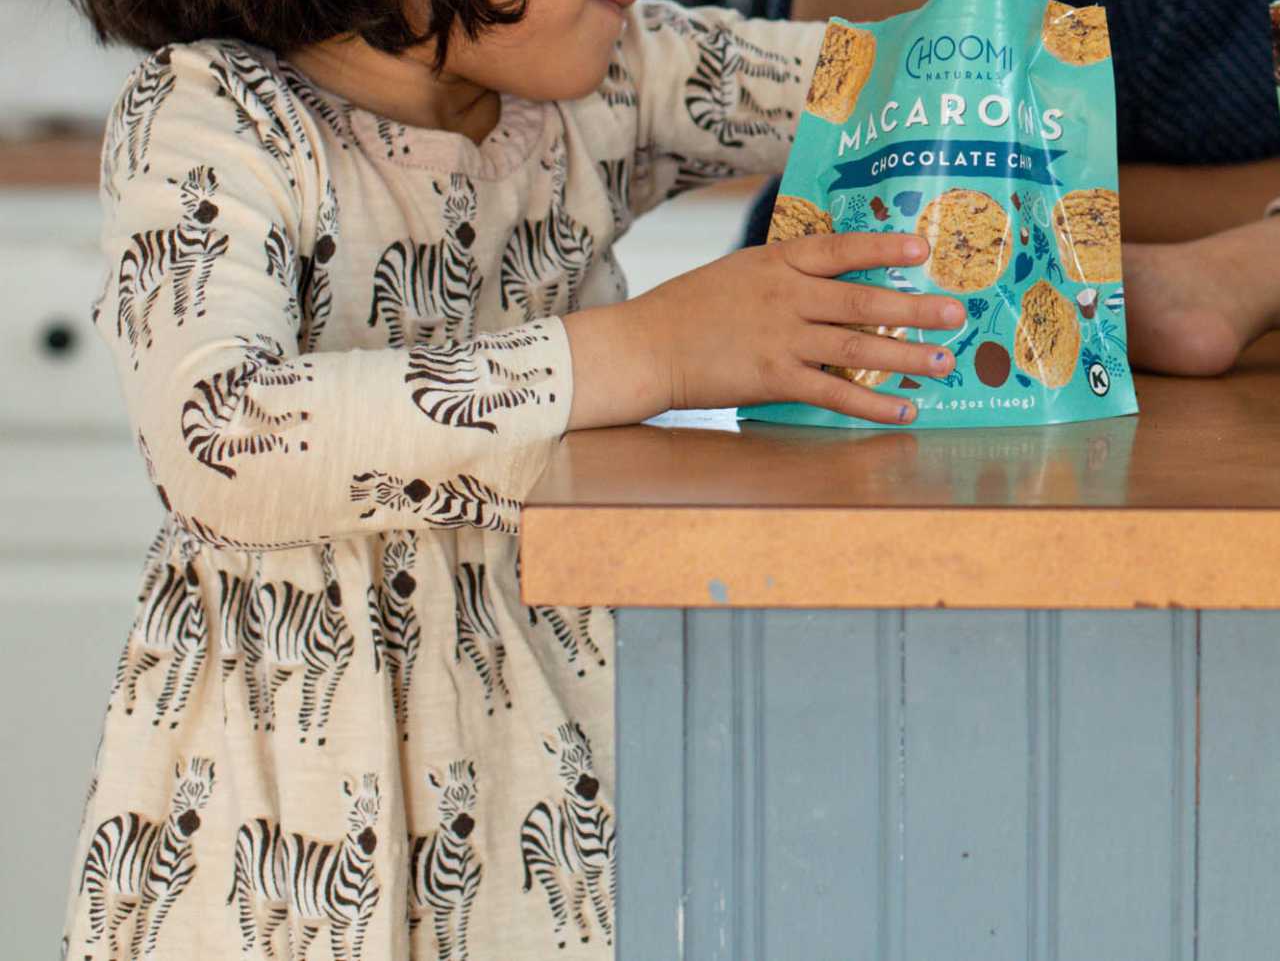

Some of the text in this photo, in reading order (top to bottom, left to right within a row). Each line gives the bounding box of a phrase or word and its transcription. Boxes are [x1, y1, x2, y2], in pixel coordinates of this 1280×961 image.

[906, 35, 1013, 79] CHOOMI
[926, 71, 1002, 80] NATURALS
[871, 151, 996, 176] CHOCOLATE
[990, 395, 1036, 411] (140g)
